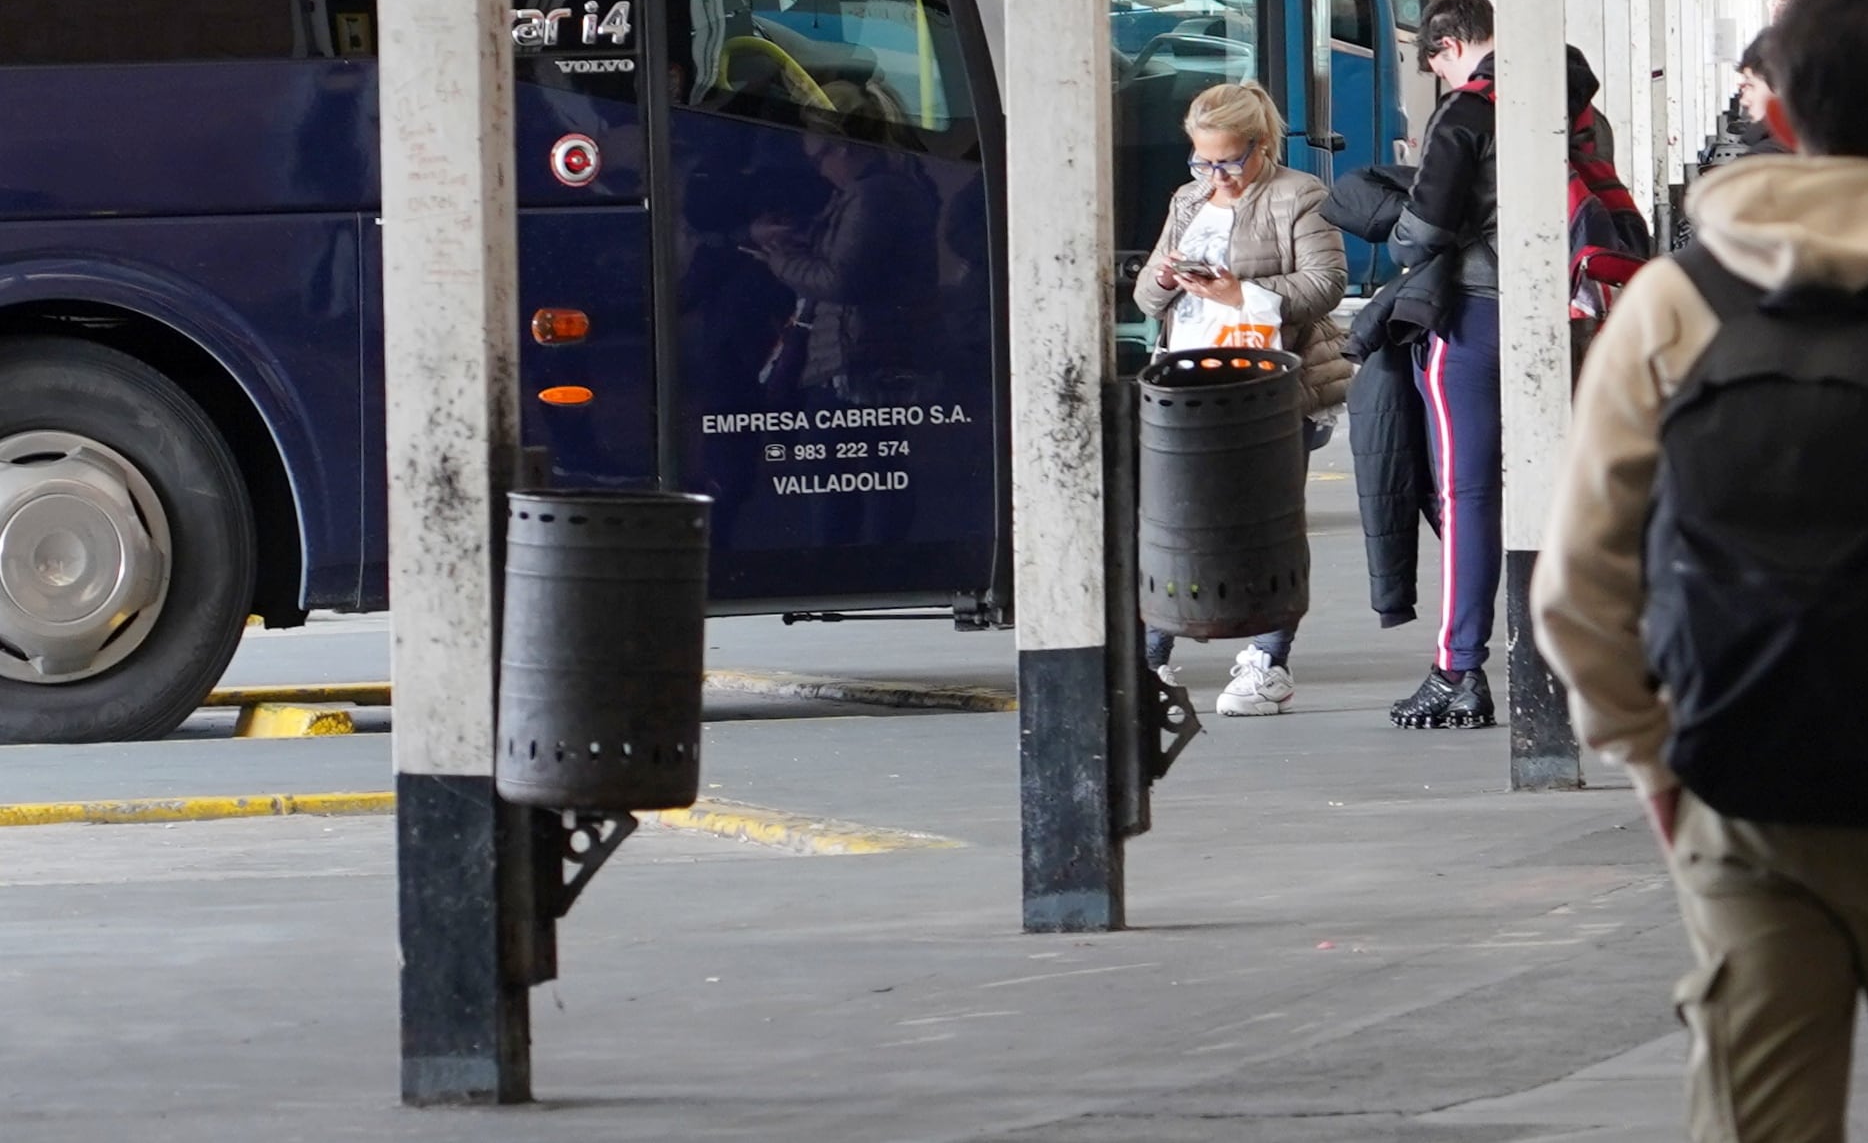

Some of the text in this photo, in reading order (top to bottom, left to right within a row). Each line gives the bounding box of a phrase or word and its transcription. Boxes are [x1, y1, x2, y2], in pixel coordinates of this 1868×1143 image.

[509, 0, 632, 47] ar i4
[554, 58, 635, 74] VOLVO
[702, 404, 973, 434] EMPRESA CABRERO S.A.
[794, 440, 910, 461] 983 222 574
[773, 471, 909, 496] VALLADOLID
